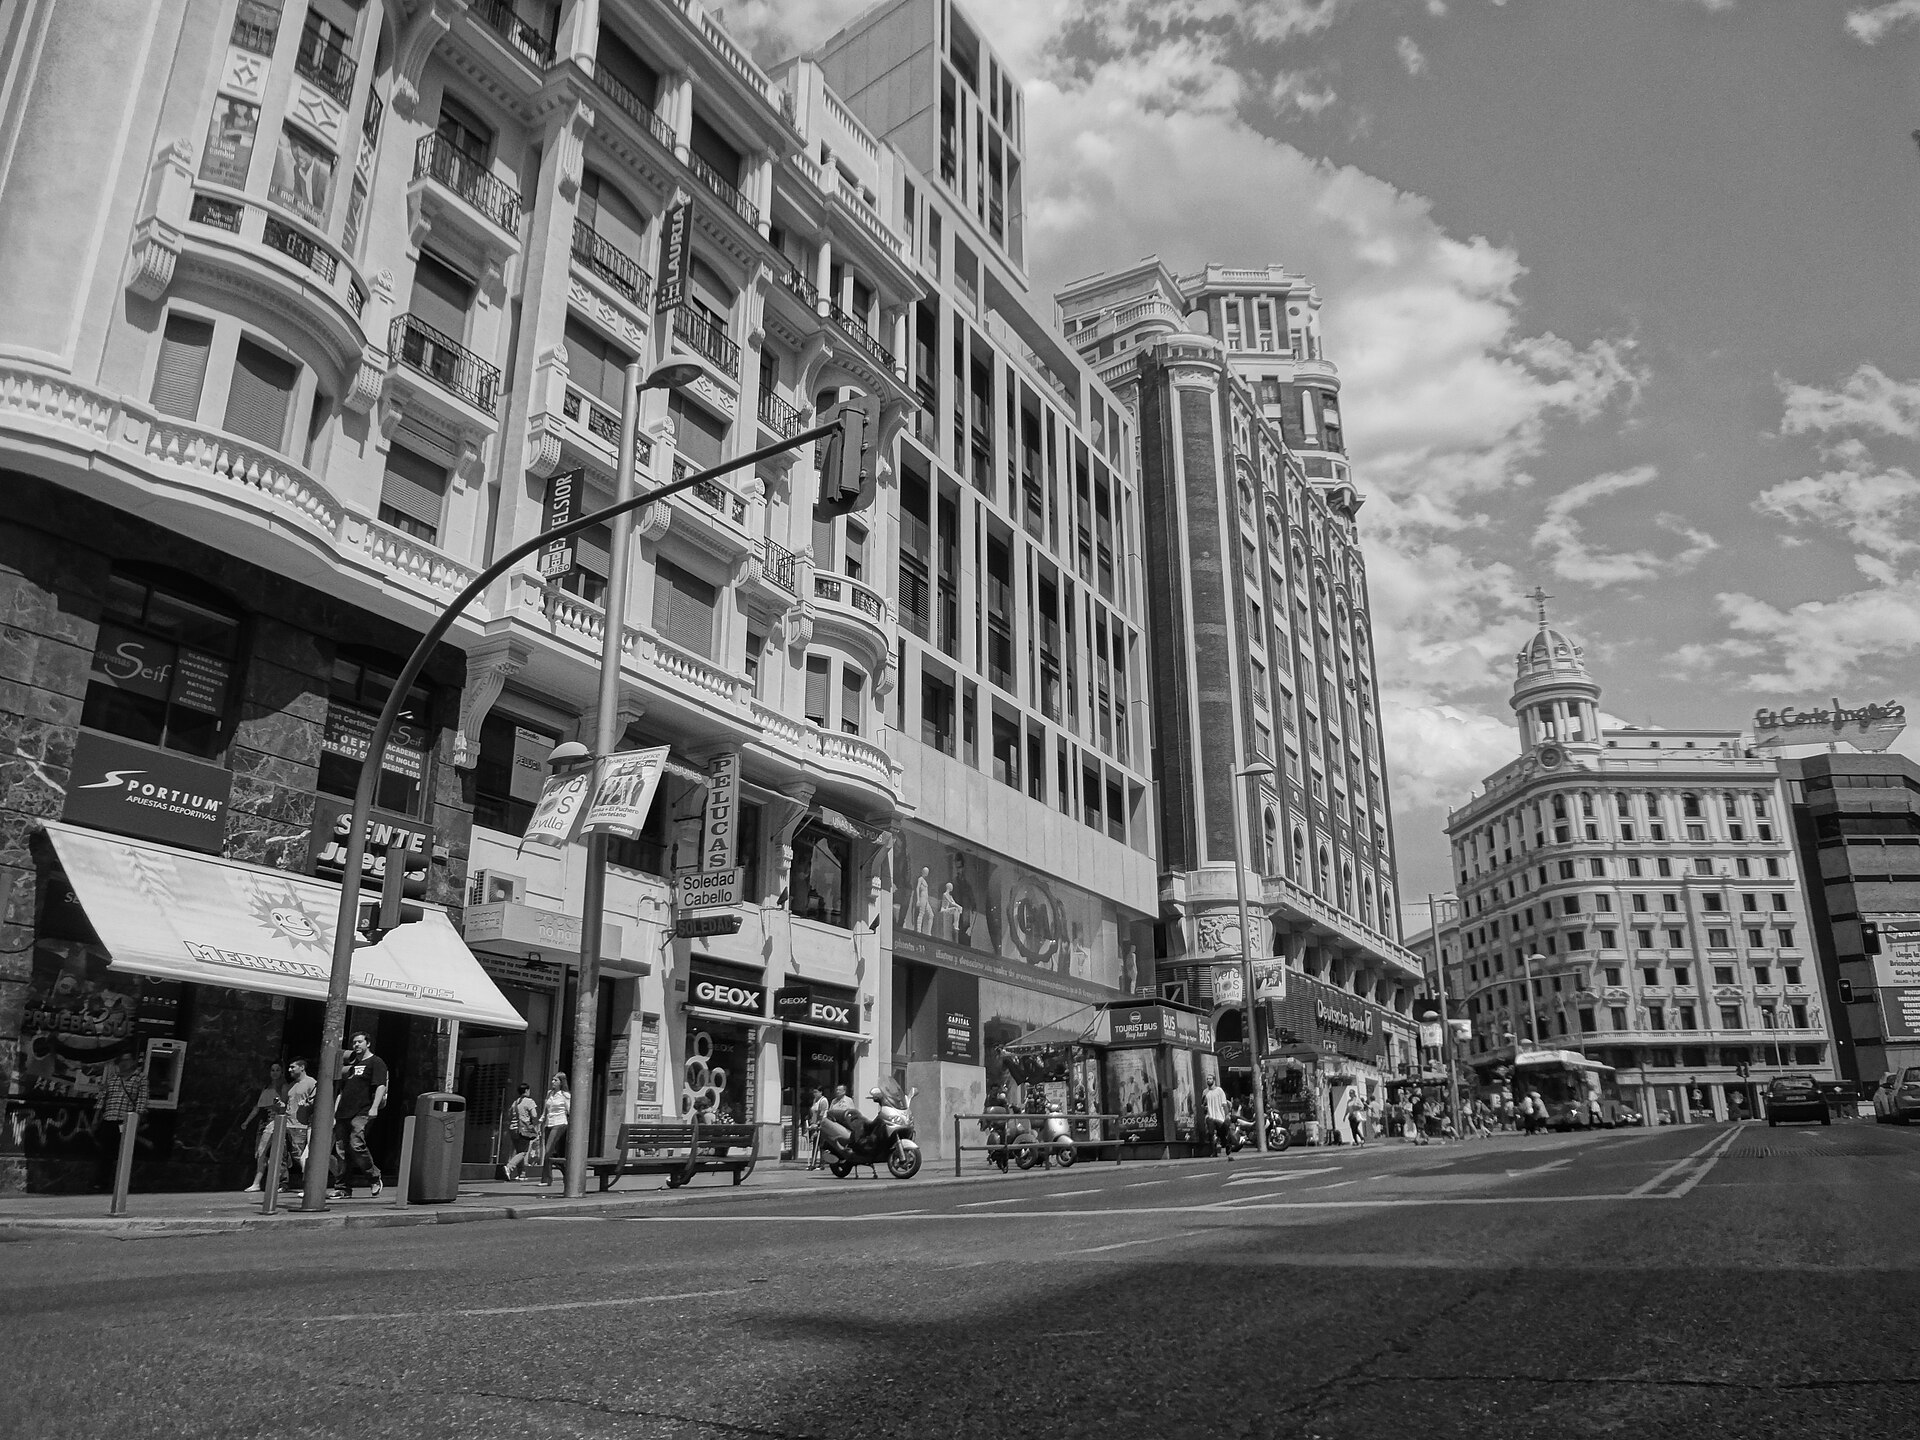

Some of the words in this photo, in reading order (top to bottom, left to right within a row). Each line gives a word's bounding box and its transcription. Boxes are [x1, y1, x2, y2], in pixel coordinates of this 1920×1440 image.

[667, 206, 685, 284] LAURIA
[1756, 708, 1779, 729] El
[1780, 706, 1831, 728] Corte
[1831, 697, 1905, 731] Inglés
[340, 745, 358, 757] 487
[385, 753, 395, 762] DE
[386, 744, 421, 760] ACADEMIA
[382, 762, 404, 774] DESDE
[664, 761, 703, 781] ENSIONES
[77, 770, 219, 813] SPORTIUM
[126, 795, 168, 811] APUESTAS
[169, 804, 217, 822] DEPORTIVAS
[708, 758, 732, 868] PELUCAS
[683, 870, 735, 891] Soledad
[684, 888, 732, 907] Cabello
[183, 940, 331, 979] MERKUR
[363, 972, 456, 1000] Juegos
[696, 981, 760, 1009] GEOX
[779, 996, 808, 1005] GEOX
[811, 1002, 850, 1024] EOX
[948, 1015, 970, 1026] CAPITAL
[1163, 1014, 1176, 1030] BUS
[1317, 999, 1349, 1028] Deutsche
[1349, 1011, 1366, 1033] Bank
[1115, 1023, 1143, 1033] TOURIST
[1143, 1022, 1158, 1031] BUS
[1199, 1028, 1211, 1044] BUS
[811, 1053, 835, 1063] GEOX
[1122, 1117, 1136, 1125] DOS
